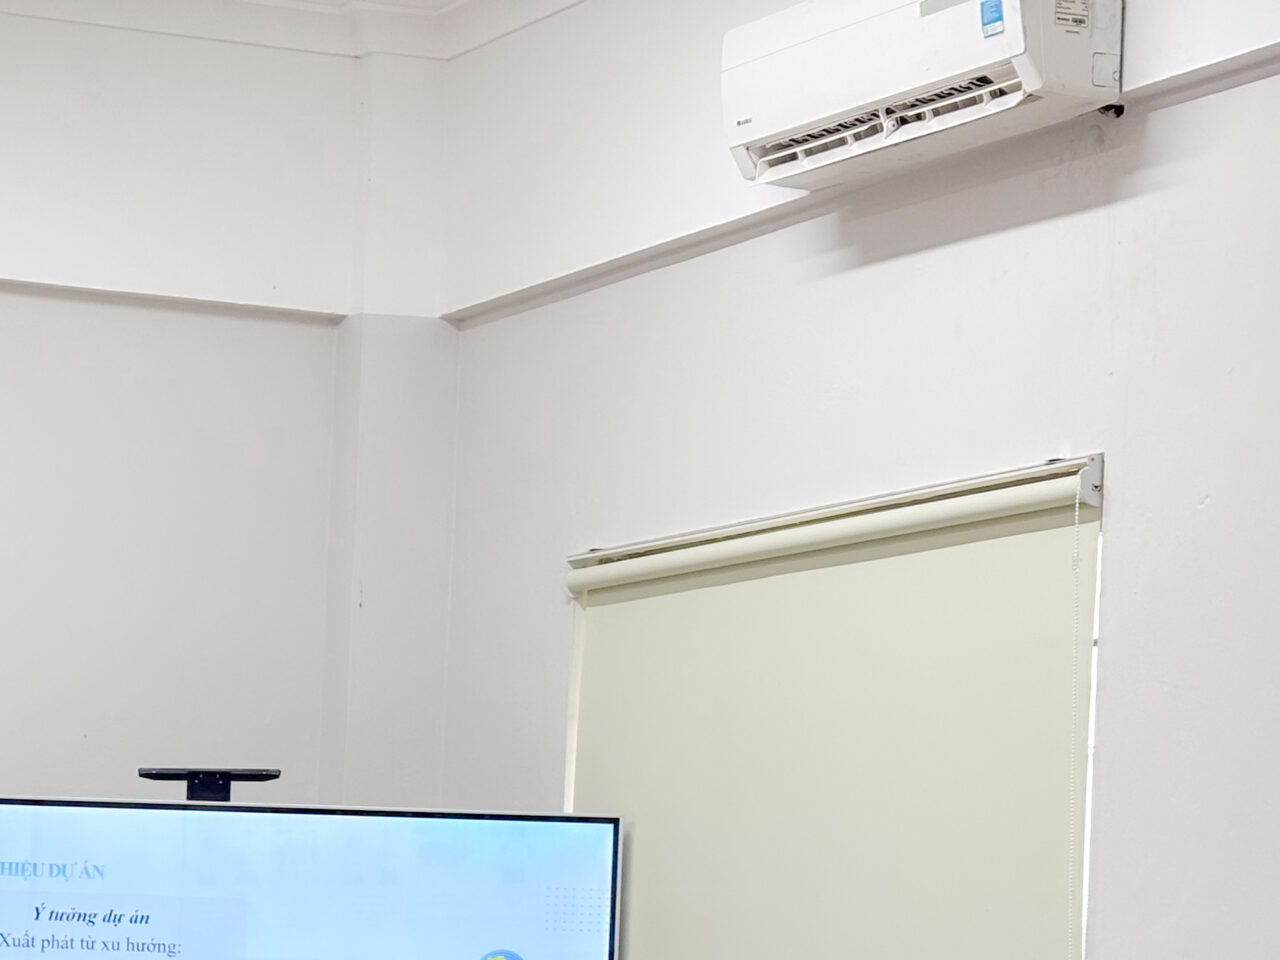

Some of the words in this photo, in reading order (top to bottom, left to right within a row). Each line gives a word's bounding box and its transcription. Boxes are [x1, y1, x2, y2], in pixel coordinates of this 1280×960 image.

[48, 862, 78, 882] DỰ
[79, 860, 105, 880] ÁN
[33, 902, 46, 921] Ý
[48, 907, 98, 926] tưởng
[102, 909, 125, 927] dự
[129, 910, 150, 925] án
[40, 934, 74, 953] phát
[80, 936, 96, 951] từ
[101, 940, 120, 952] xu
[126, 937, 181, 957] hướng:
